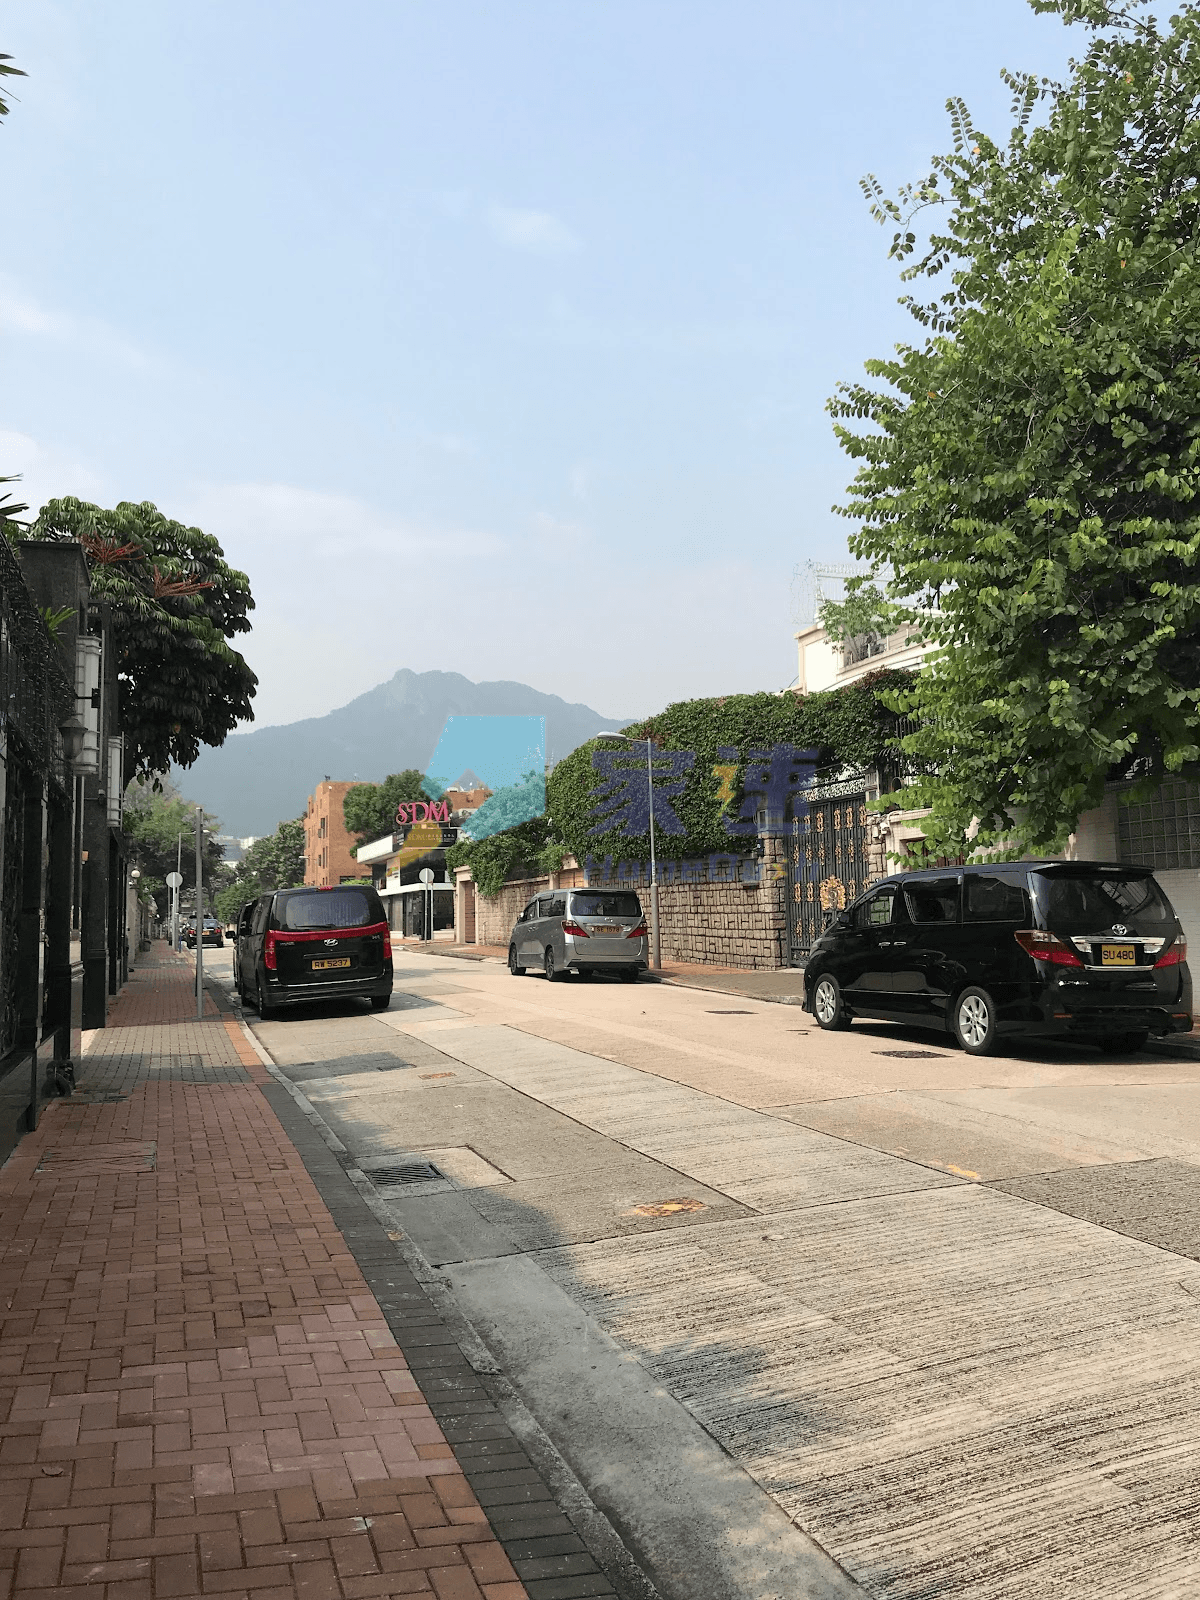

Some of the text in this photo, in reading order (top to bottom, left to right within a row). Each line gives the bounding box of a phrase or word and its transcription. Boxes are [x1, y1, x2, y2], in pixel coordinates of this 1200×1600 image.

[396, 800, 449, 824] SDM
[1102, 950, 1134, 960] SU 480
[327, 959, 348, 967] 5237
